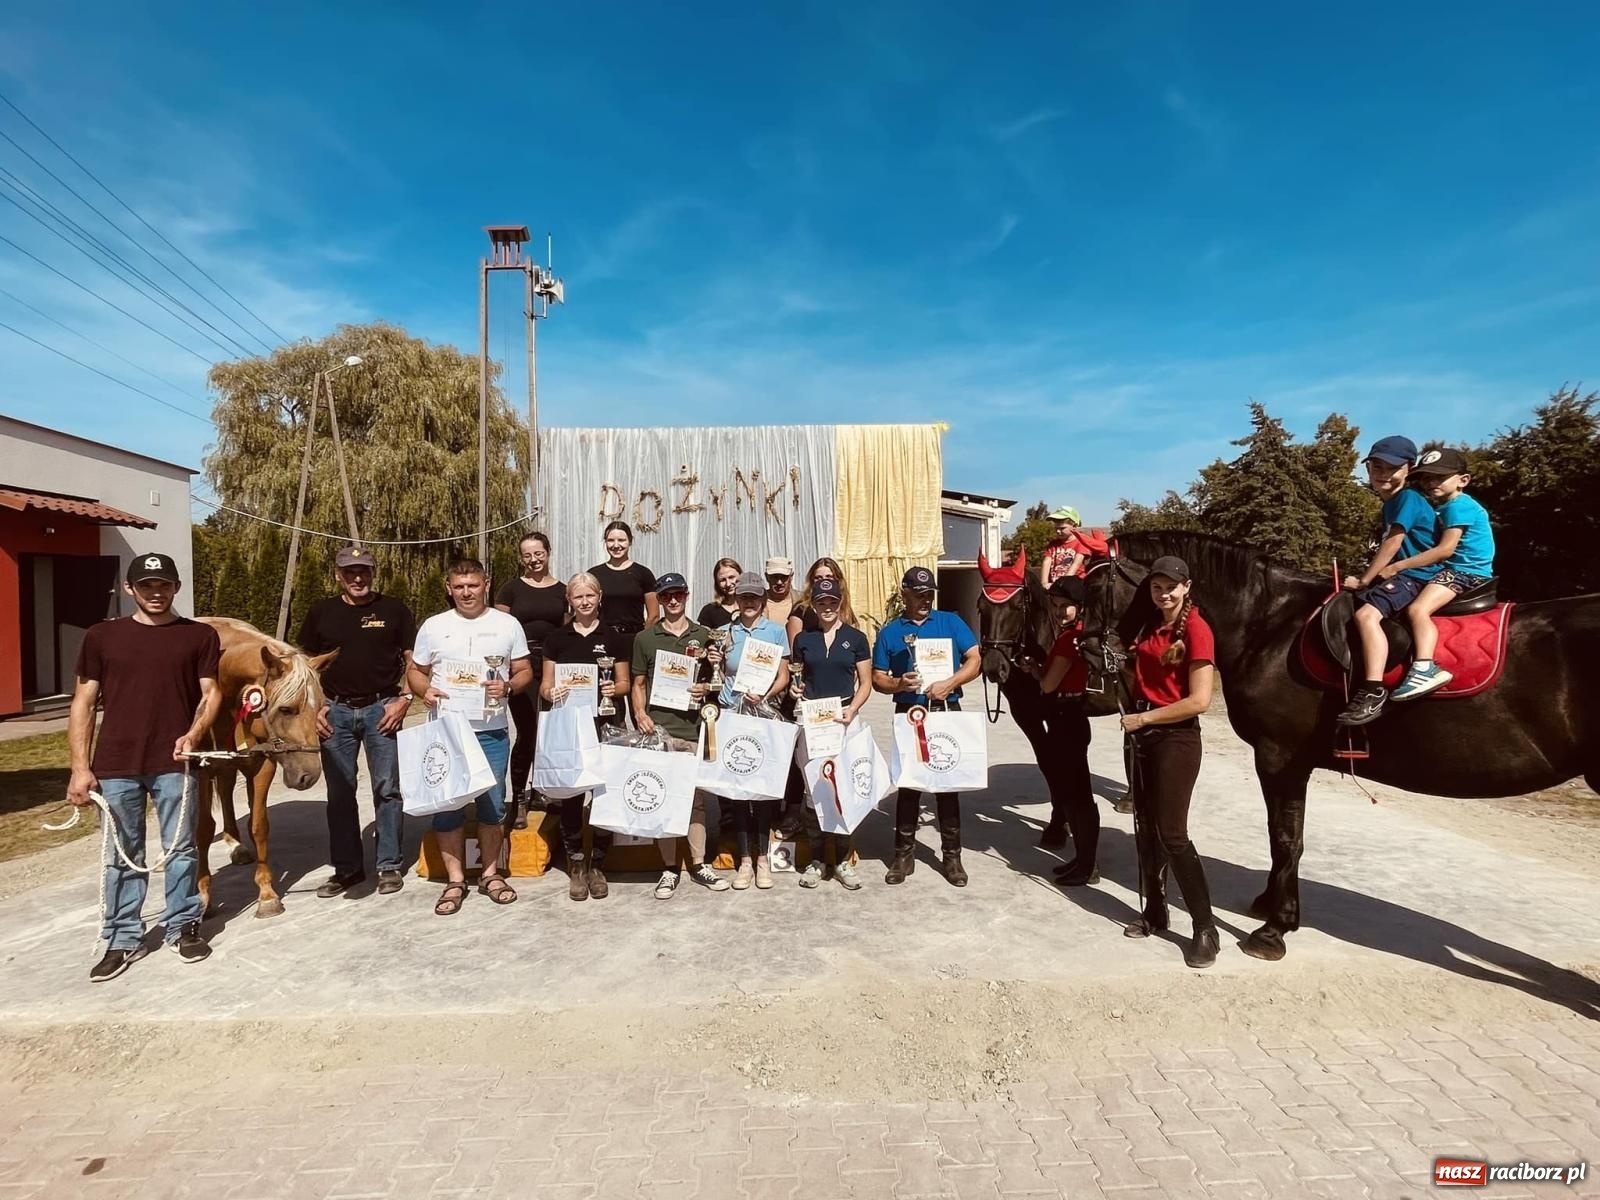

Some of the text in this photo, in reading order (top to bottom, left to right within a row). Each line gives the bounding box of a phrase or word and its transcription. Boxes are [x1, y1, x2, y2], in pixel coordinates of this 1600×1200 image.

[599, 464, 801, 533] DOŻYNKI
[748, 640, 779, 657] DYPLOM
[446, 661, 482, 674] DYPLOM
[660, 652, 692, 668] DYPLOM
[560, 664, 594, 676] DYPLOM
[774, 847, 791, 869] 3
